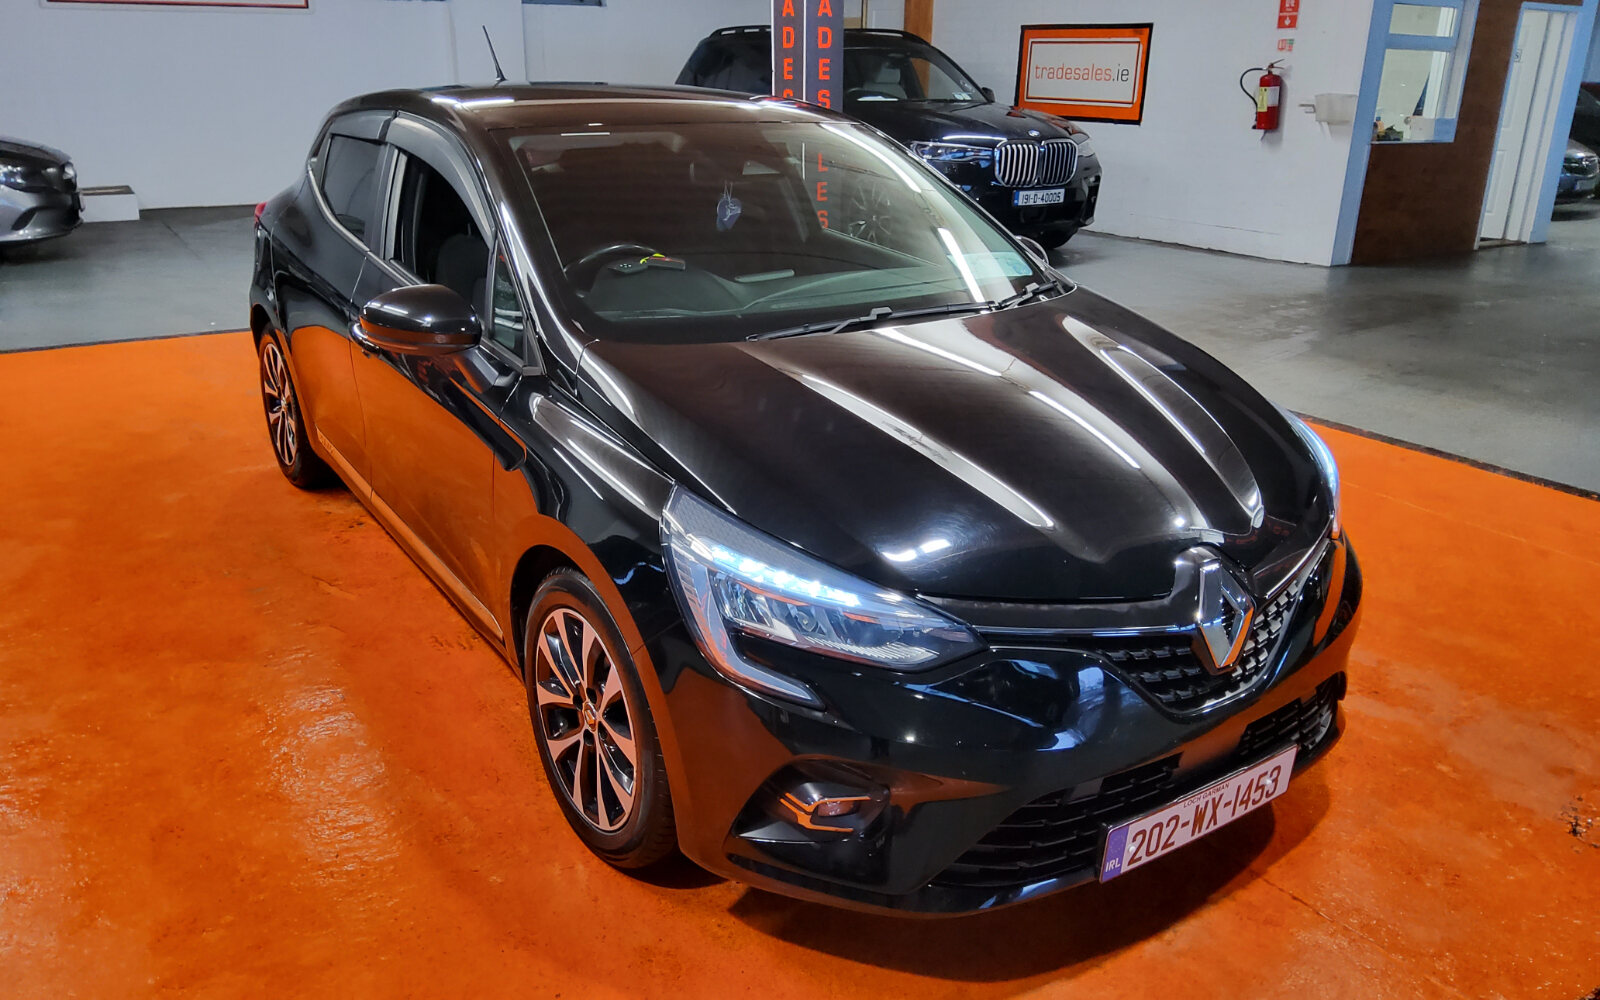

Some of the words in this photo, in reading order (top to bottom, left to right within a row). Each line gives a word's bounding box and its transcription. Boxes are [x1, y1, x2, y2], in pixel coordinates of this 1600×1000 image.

[1034, 63, 1130, 82] tradesales.ie
[1126, 764, 1282, 867] 202-WX-1453
[1105, 857, 1121, 872] IRL
